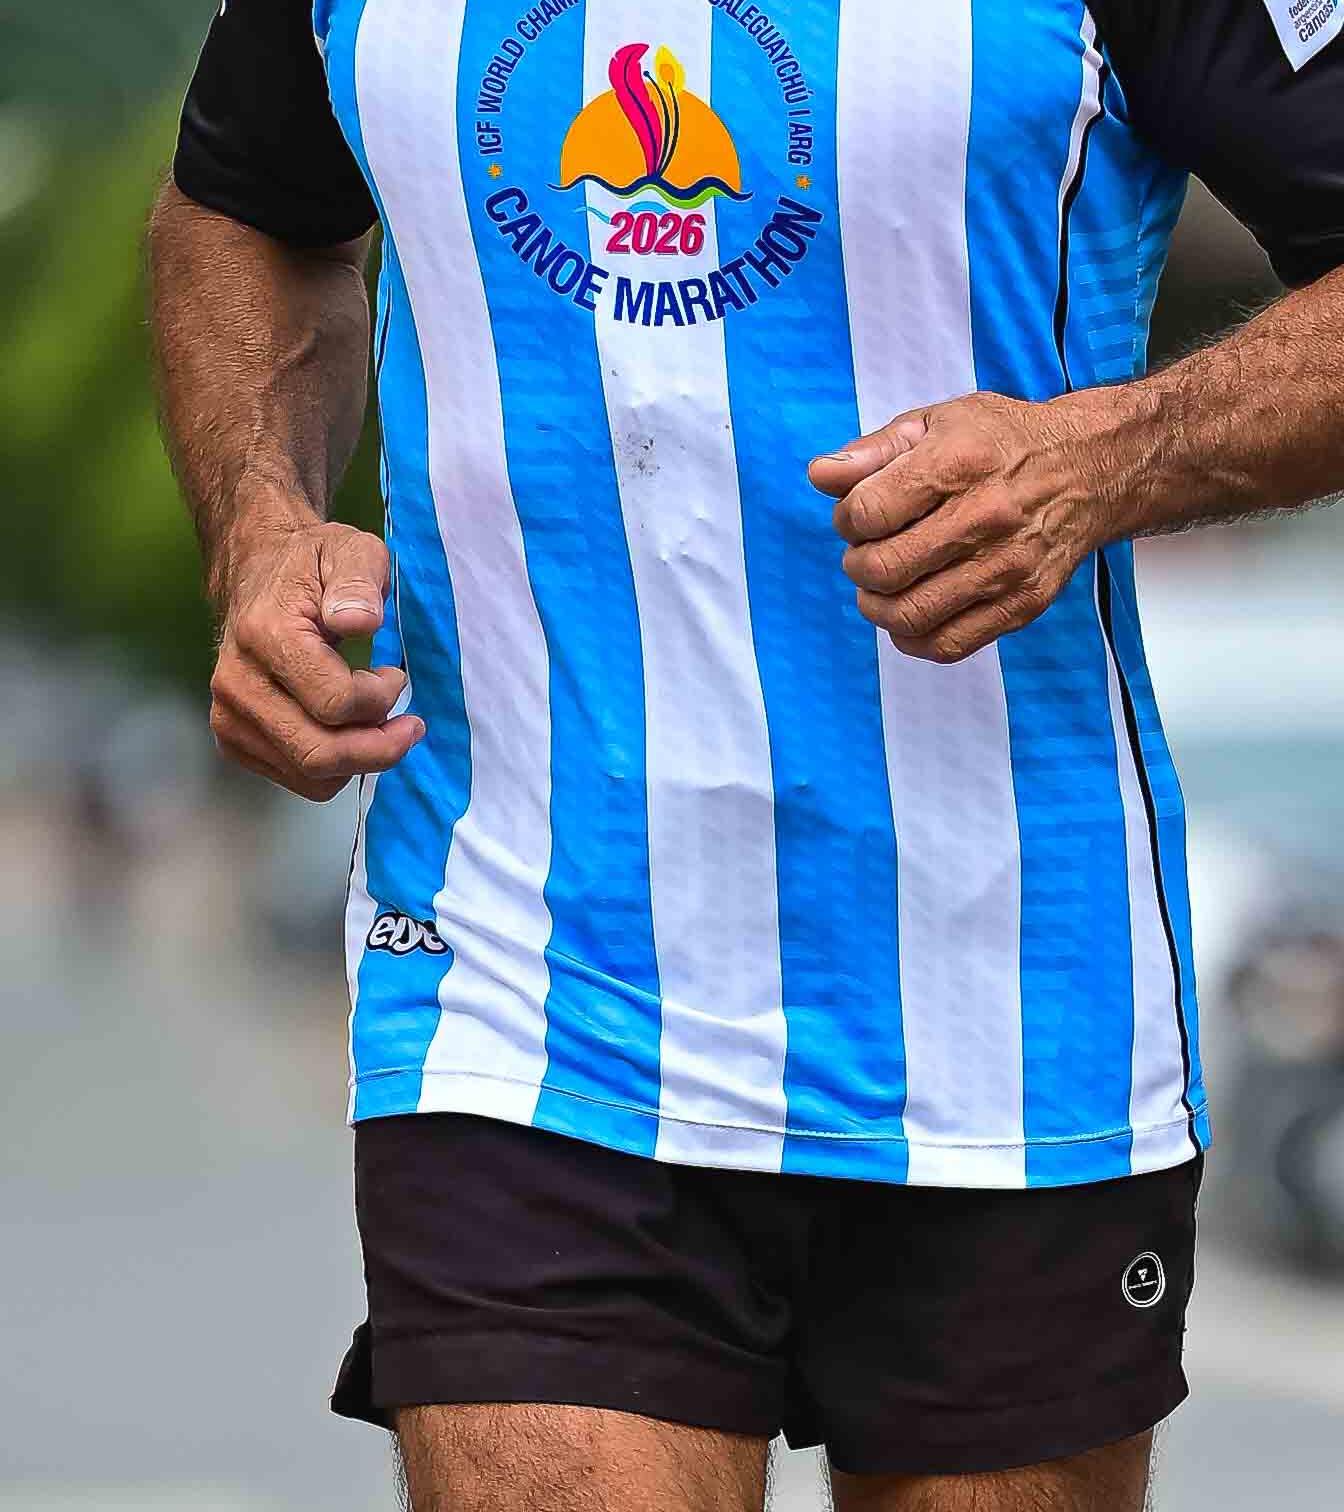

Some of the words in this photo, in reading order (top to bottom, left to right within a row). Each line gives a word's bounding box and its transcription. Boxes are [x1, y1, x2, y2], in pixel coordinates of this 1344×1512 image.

[477, 38, 525, 113] WORLD
[477, 121, 503, 156] ICF
[787, 122, 813, 166] ARG
[606, 212, 706, 256] 2026
[485, 188, 610, 311] CANOE
[613, 195, 823, 327] MARATHON
